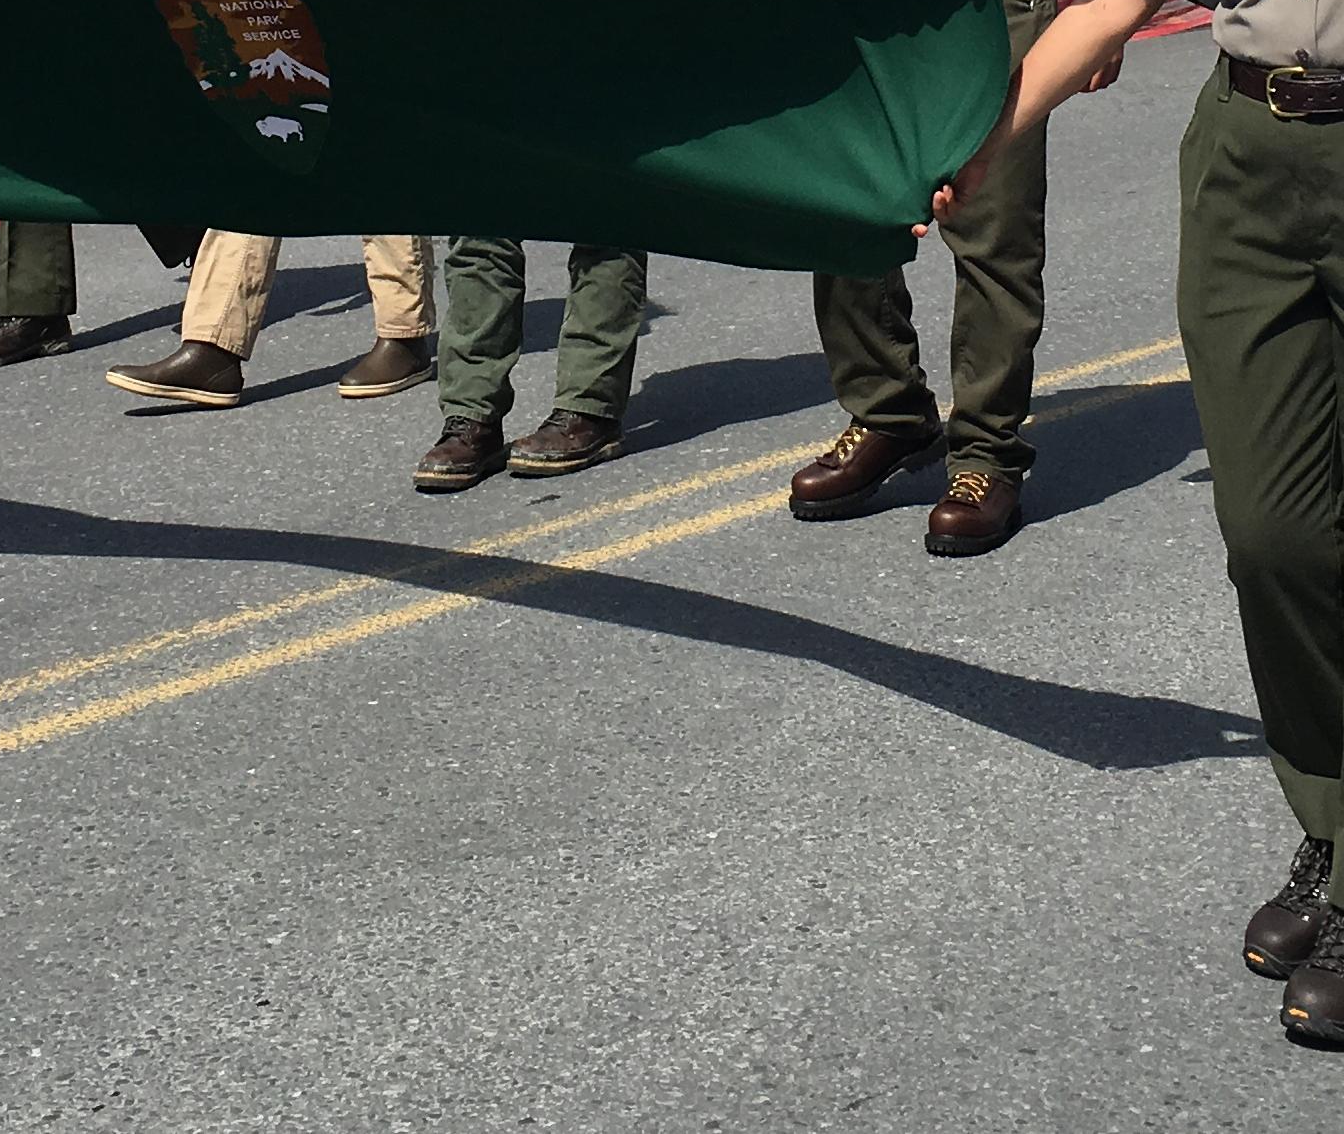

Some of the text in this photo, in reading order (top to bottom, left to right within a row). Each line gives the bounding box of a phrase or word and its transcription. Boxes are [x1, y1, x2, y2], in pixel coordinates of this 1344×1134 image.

[219, 0, 295, 13] NATIONAL
[246, 15, 283, 27] PARK
[242, 29, 302, 42] SERVICE
